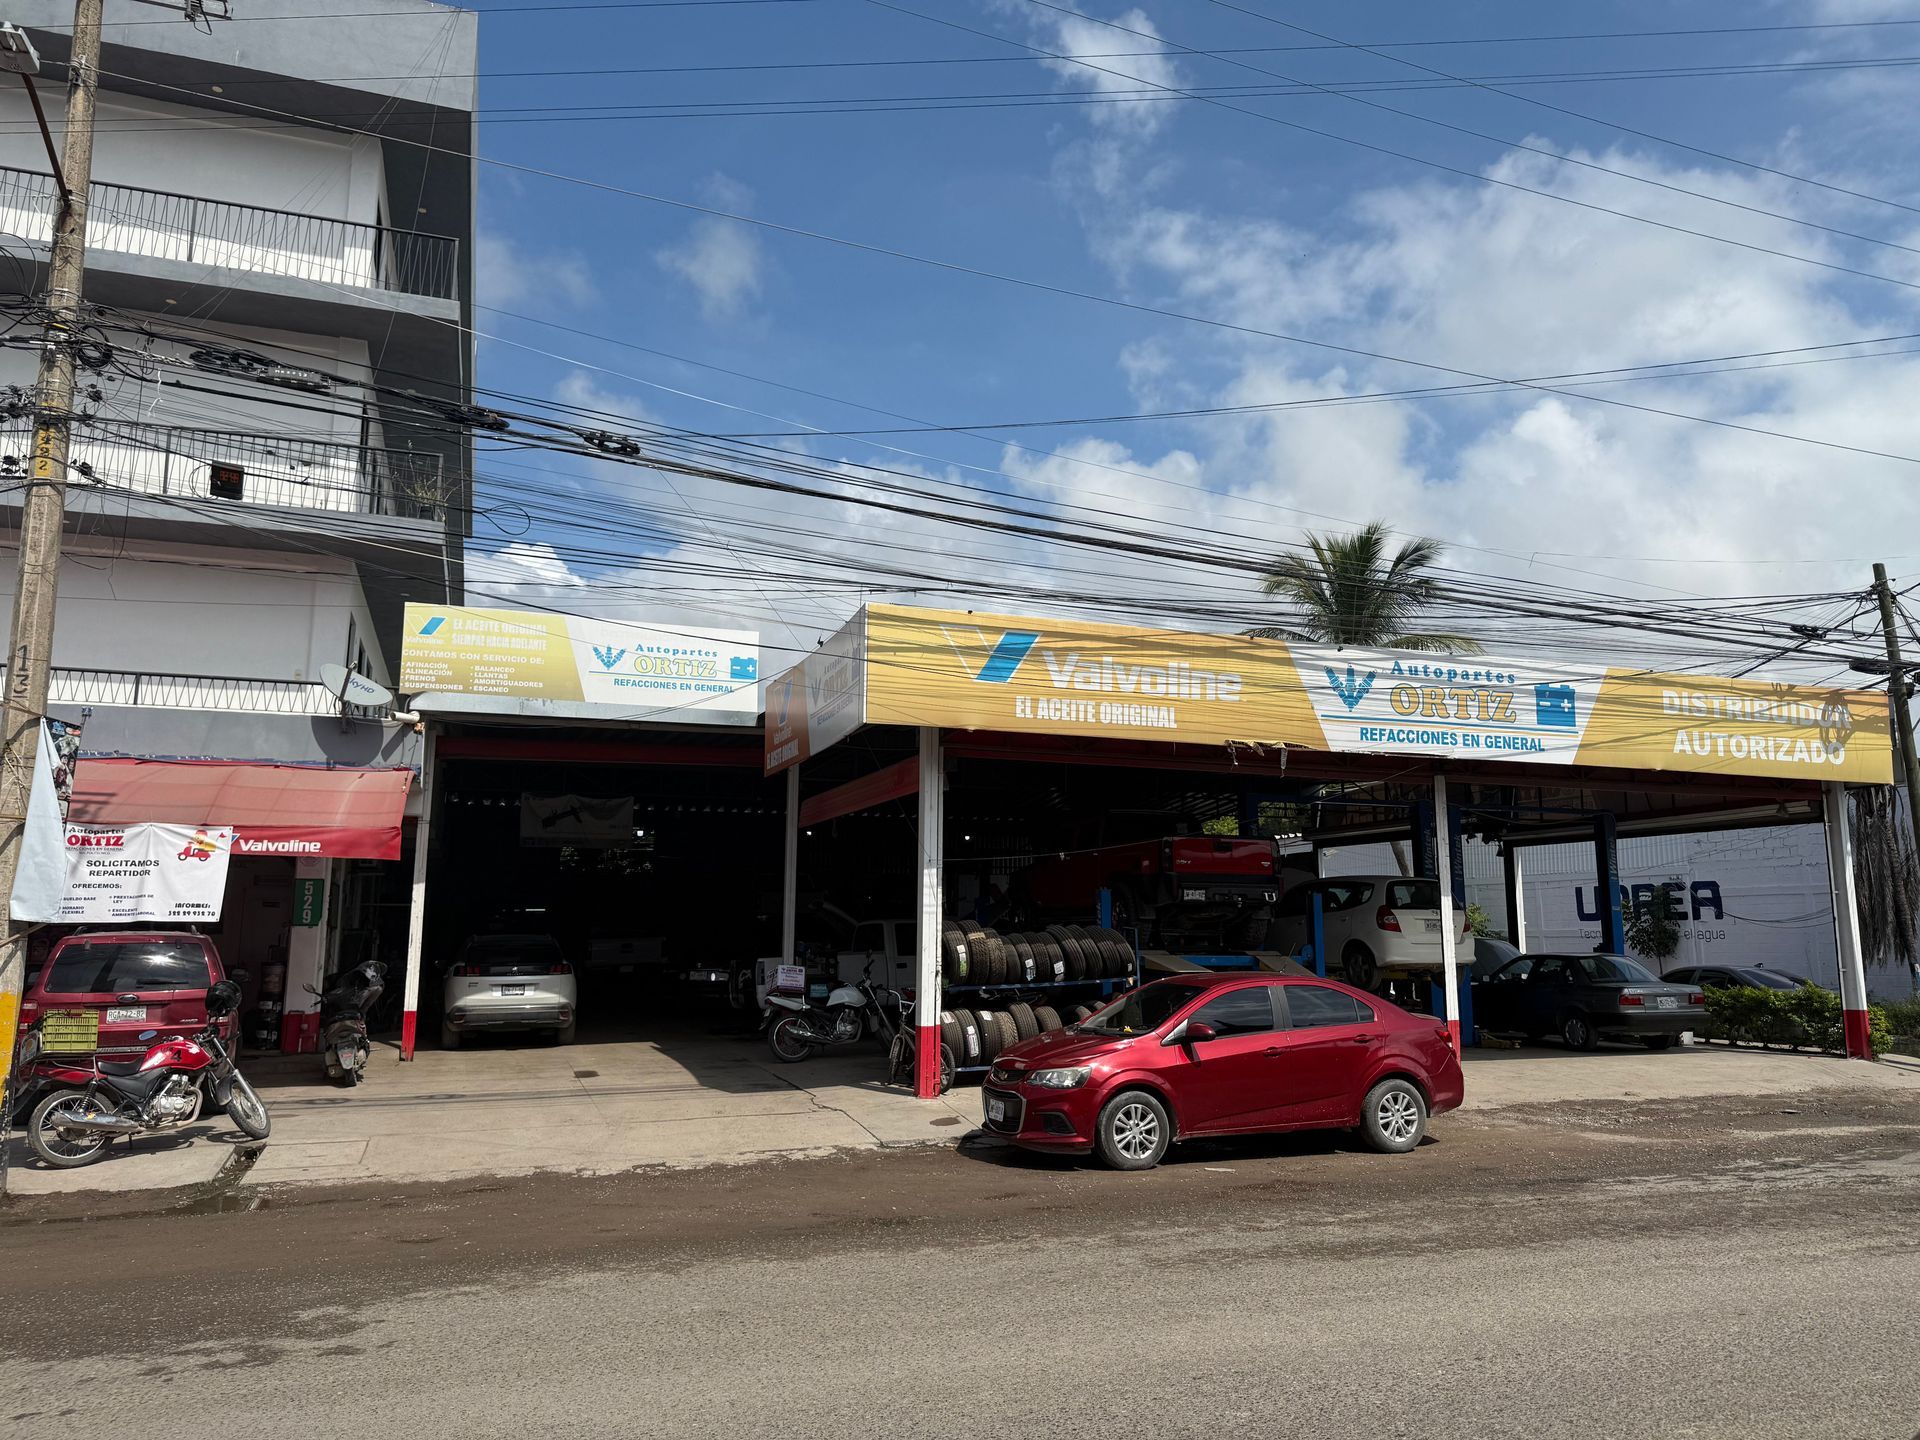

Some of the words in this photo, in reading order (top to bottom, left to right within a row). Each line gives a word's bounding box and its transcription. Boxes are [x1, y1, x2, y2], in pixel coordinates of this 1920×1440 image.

[402, 649, 457, 659] CONTAMOS
[460, 652, 480, 660] CON
[483, 654, 528, 664] SERVICIO
[530, 657, 544, 665] DE:
[635, 643, 718, 657] Autopartes
[405, 667, 453, 676] ALINEACIÓN
[406, 660, 448, 669] AFINACIÓN
[475, 665, 515, 673] BALANCEO
[634, 655, 718, 678] ORTIZ
[1390, 660, 1515, 684] Autopartes
[473, 679, 544, 688] AMORTIGUADORES
[1042, 650, 1242, 702] Valvoline
[404, 682, 463, 690] SUSPENSIONES
[614, 678, 677, 690] REFACCIONES
[680, 682, 692, 691] EN
[694, 683, 735, 693] GENERAL
[1390, 683, 1517, 723] ORTIZ
[1662, 690, 1852, 729] DISTRIBUIDOR
[1015, 696, 1033, 718] EL
[1036, 697, 1096, 723] ACEITE
[1100, 701, 1178, 729] ORIGINAL
[1360, 727, 1458, 746] REFACCIONES
[1462, 733, 1480, 748] EN
[1484, 736, 1545, 751] GENERAL
[1673, 729, 1846, 765] AUTORIZADO
[67, 834, 124, 847] ORTIZ
[86, 859, 160, 867] SOLICITAMOS
[89, 869, 151, 877] REPARTIDOR
[302, 881, 314, 923] 529
[1696, 930, 1726, 943] agua
